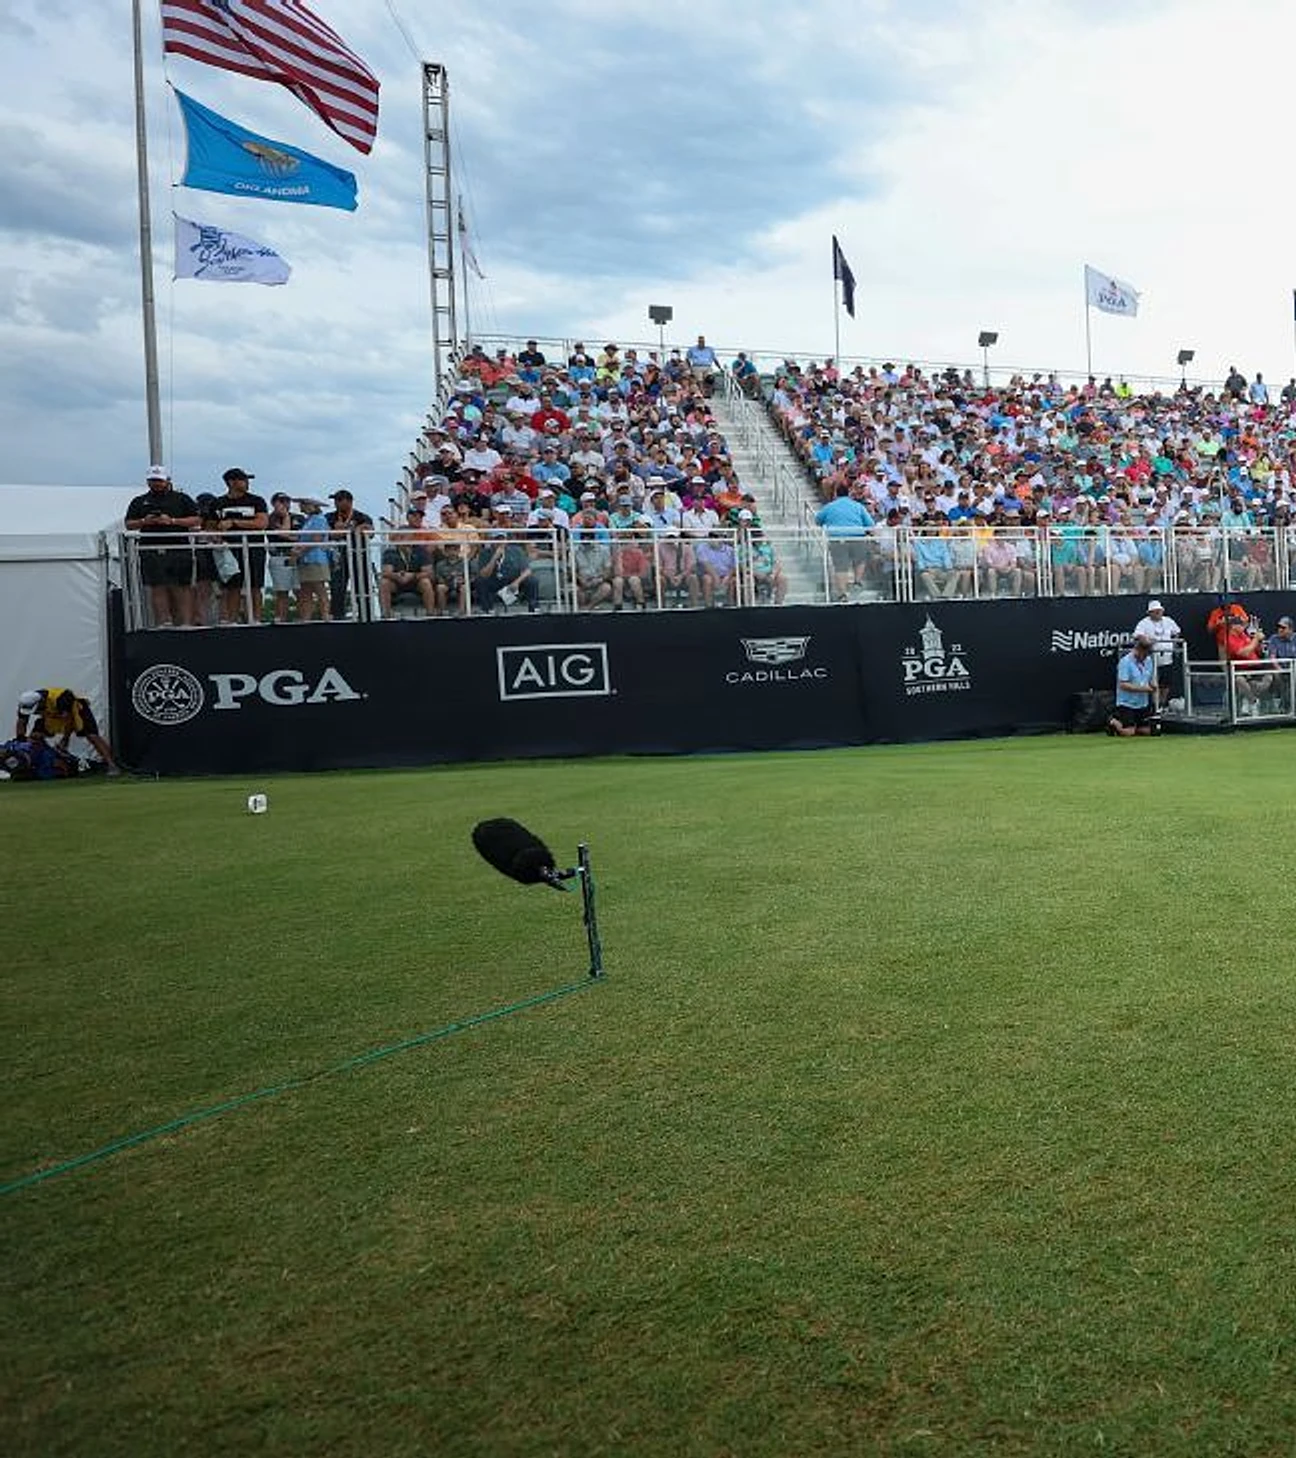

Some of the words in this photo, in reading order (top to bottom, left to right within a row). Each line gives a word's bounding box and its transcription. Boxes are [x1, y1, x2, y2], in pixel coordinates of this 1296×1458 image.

[1073, 630, 1135, 650] Nation
[514, 653, 595, 688] AIG
[725, 667, 830, 684] CADILLAC
[902, 656, 970, 681] PGA
[146, 688, 190, 703] PGA
[209, 667, 360, 709] PGA
